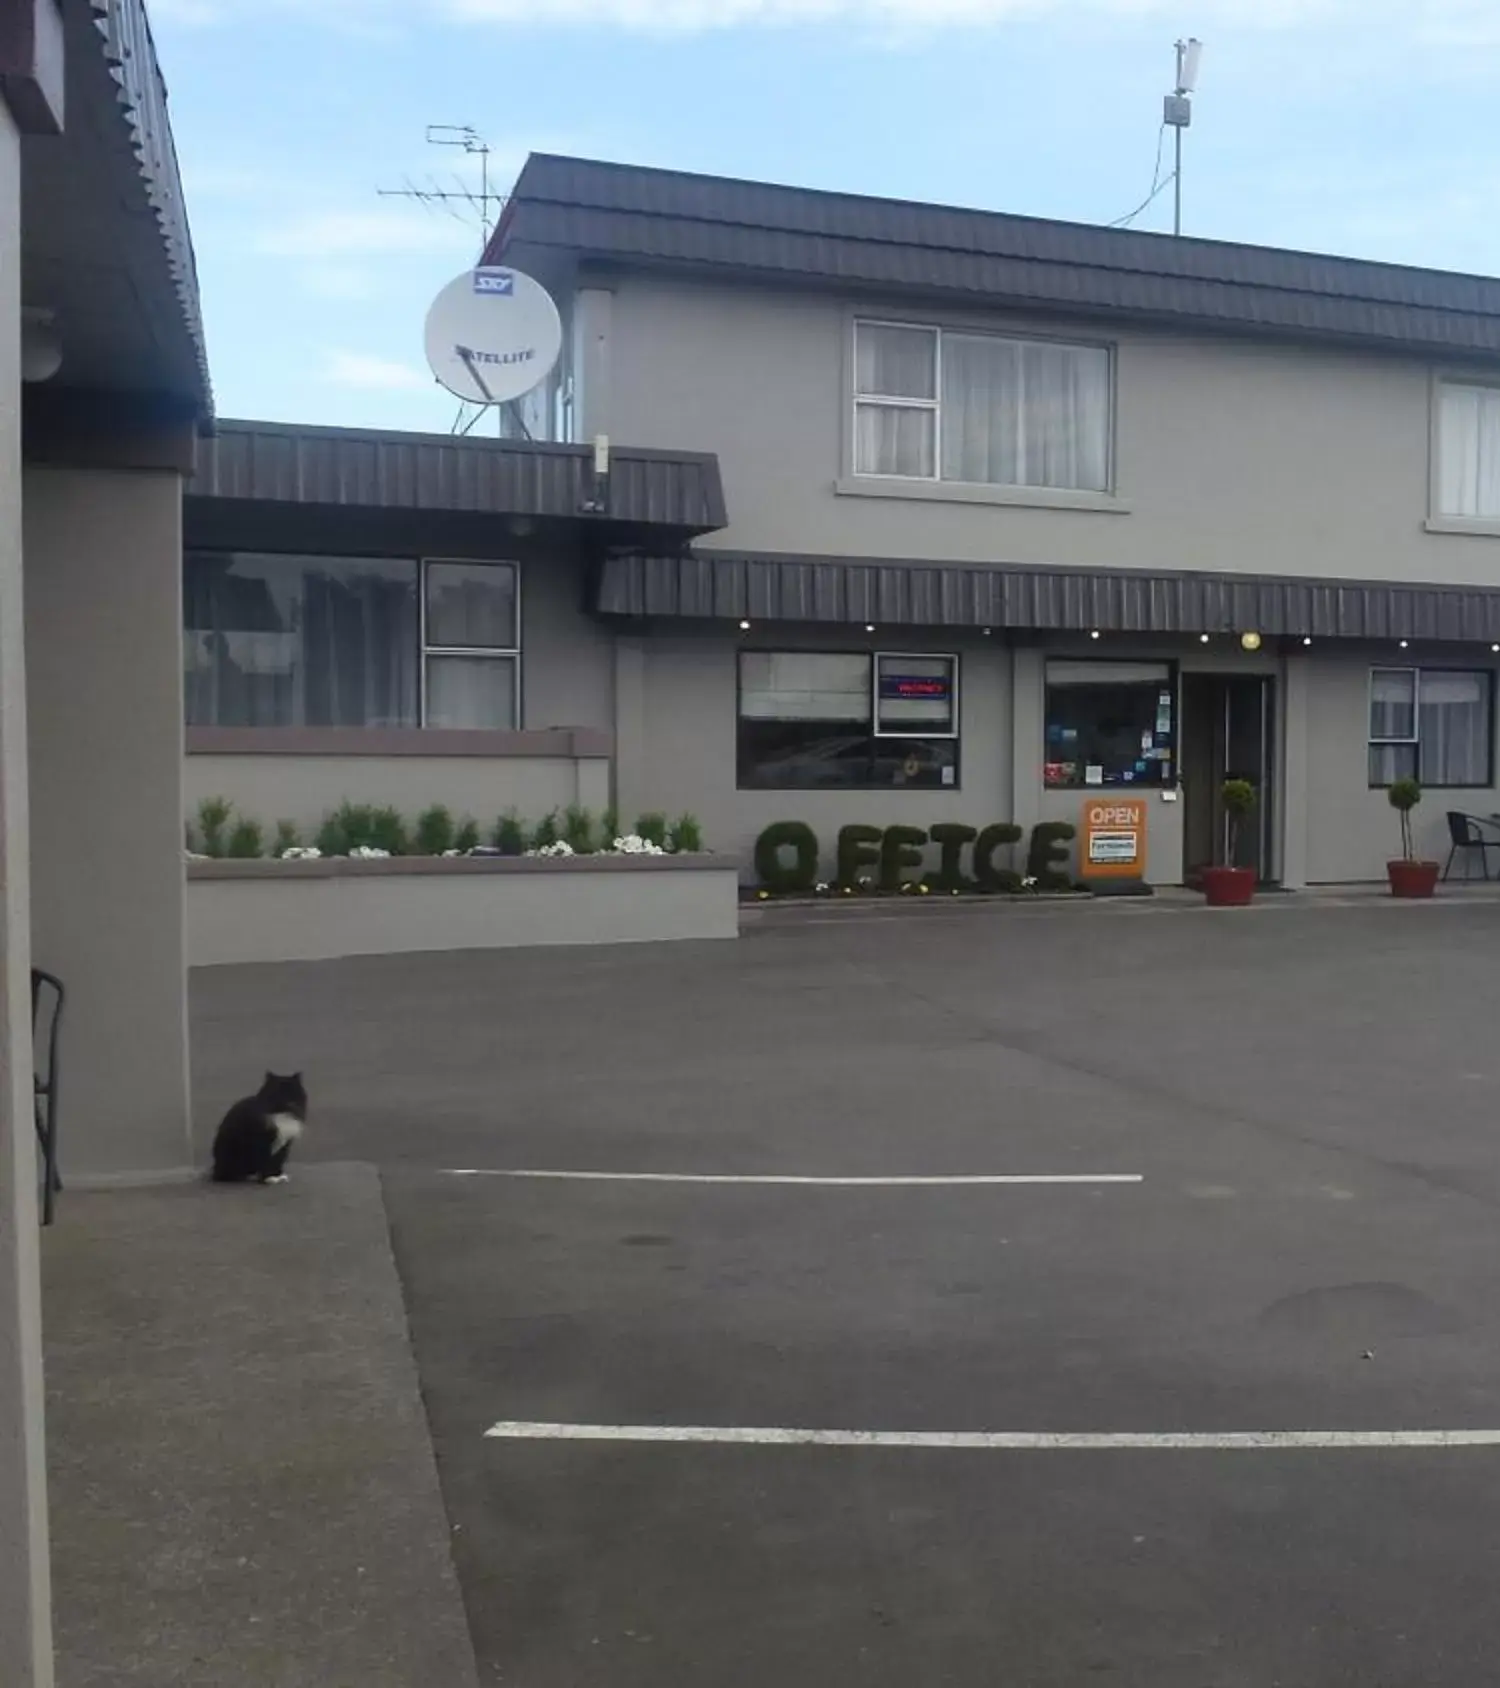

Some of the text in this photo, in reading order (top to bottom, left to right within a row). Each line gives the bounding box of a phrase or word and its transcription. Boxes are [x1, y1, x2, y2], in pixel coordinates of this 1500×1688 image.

[474, 278, 512, 291] SKY
[460, 347, 536, 365] ATELLITE
[1090, 806, 1139, 824] OPEN
[755, 820, 1076, 890] OFFICE
